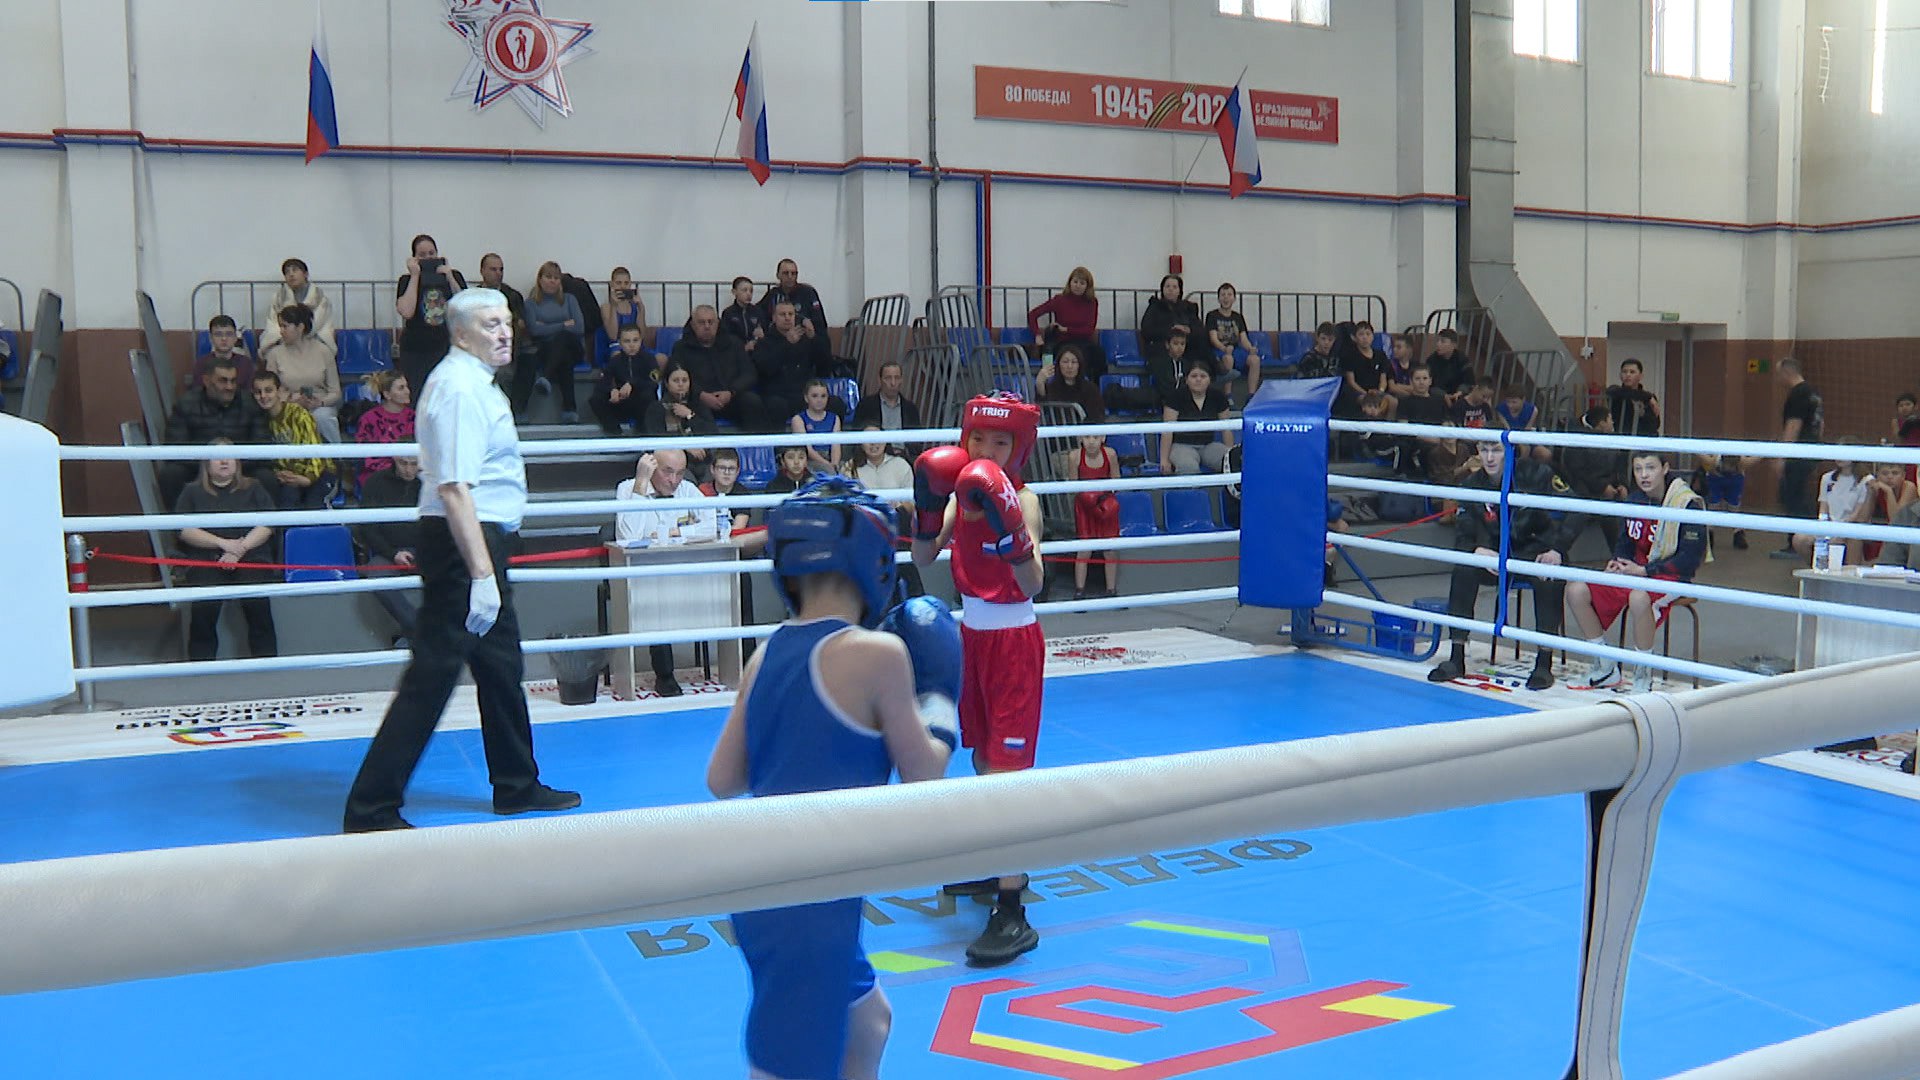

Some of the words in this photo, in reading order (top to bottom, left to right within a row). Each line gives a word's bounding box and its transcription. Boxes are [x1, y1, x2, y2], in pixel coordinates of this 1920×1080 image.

[1005, 85, 1022, 102] 80
[1024, 88, 1071, 105] ПОБЕДА!
[1091, 84, 1153, 120] 1945
[1181, 93, 1226, 125] 202
[1255, 103, 1261, 113] С
[1266, 423, 1313, 433] OLYMP
[626, 837, 1313, 959] ФЕДЕАЯ
